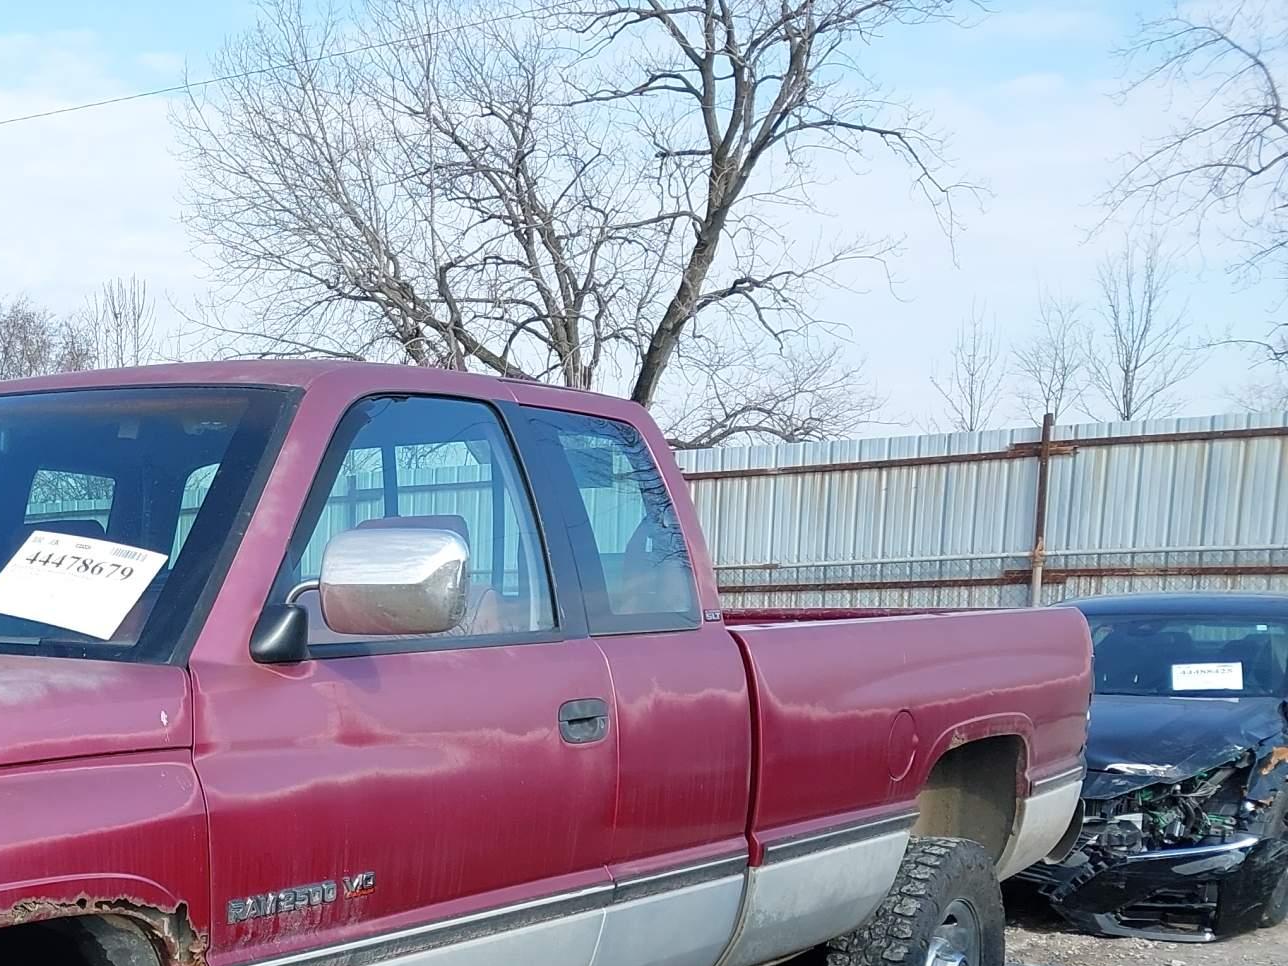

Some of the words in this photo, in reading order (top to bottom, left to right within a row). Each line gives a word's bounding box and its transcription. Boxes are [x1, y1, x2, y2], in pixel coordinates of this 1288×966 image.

[25, 550, 134, 582] 44478679
[227, 893, 278, 925] RAM
[278, 880, 337, 914] 2500
